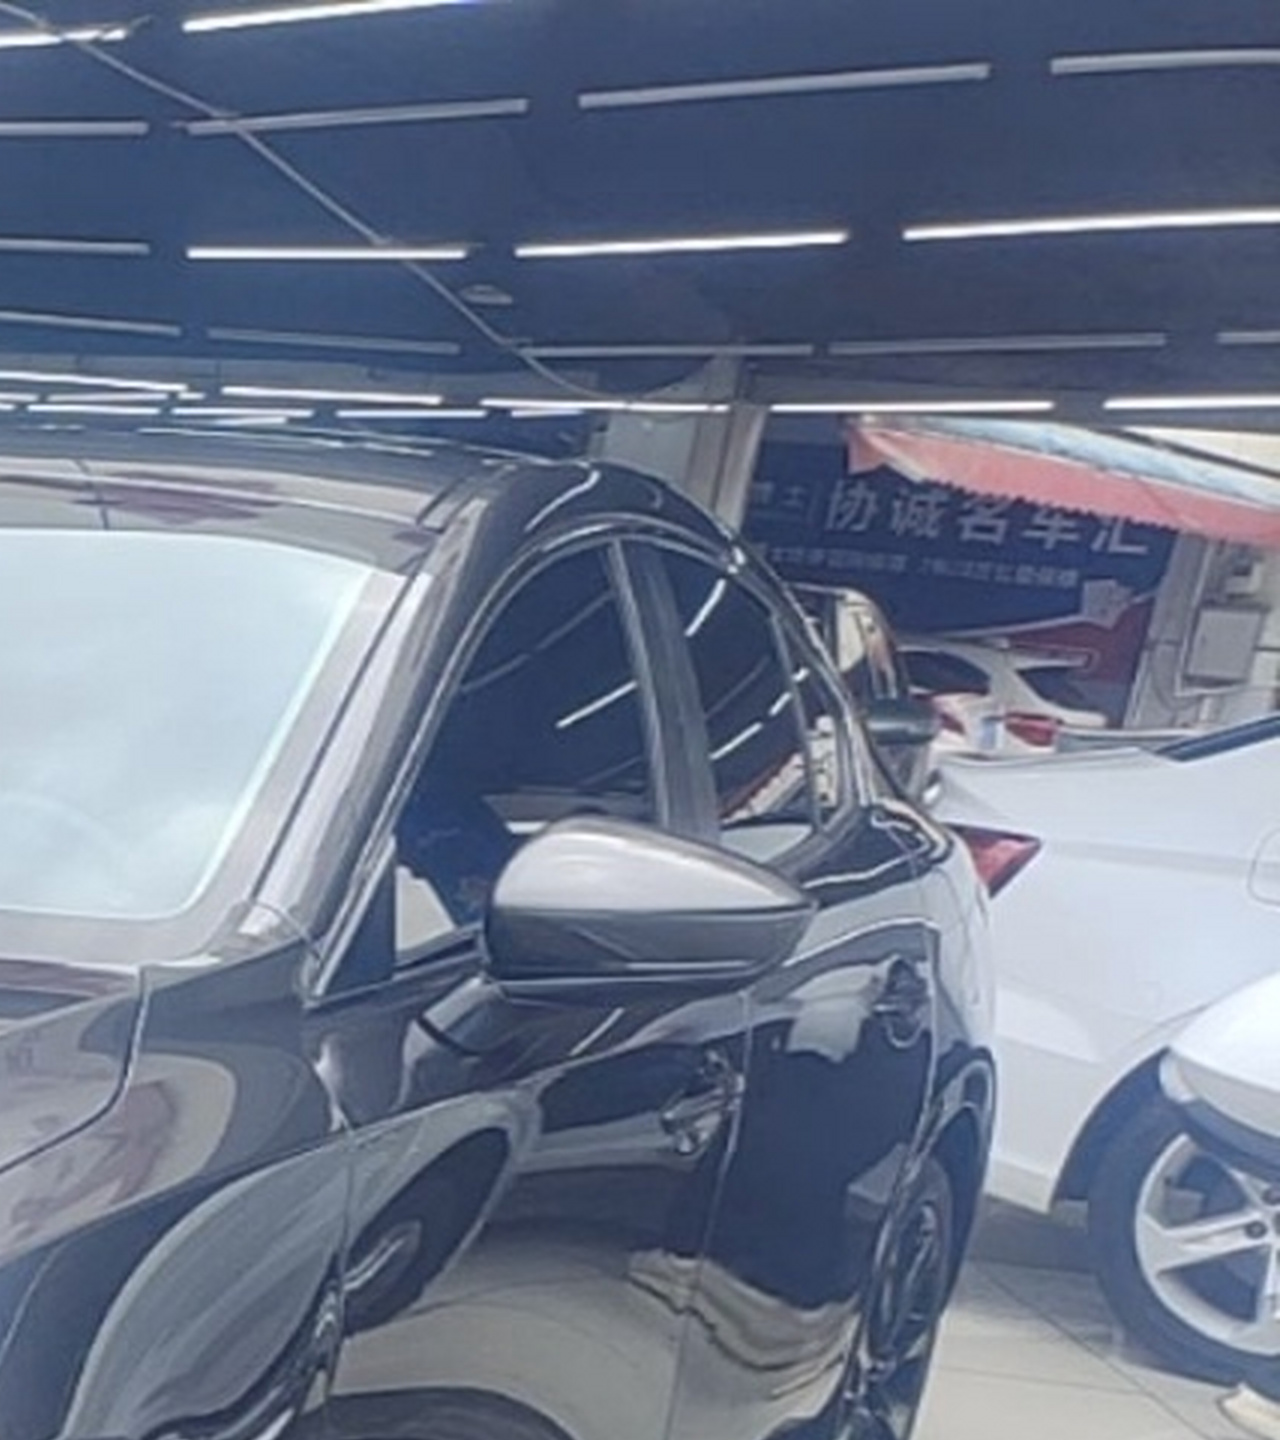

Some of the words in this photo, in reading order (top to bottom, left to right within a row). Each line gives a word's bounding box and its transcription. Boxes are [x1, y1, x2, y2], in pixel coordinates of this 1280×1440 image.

[826, 479, 1149, 556] 协诚名车汇
